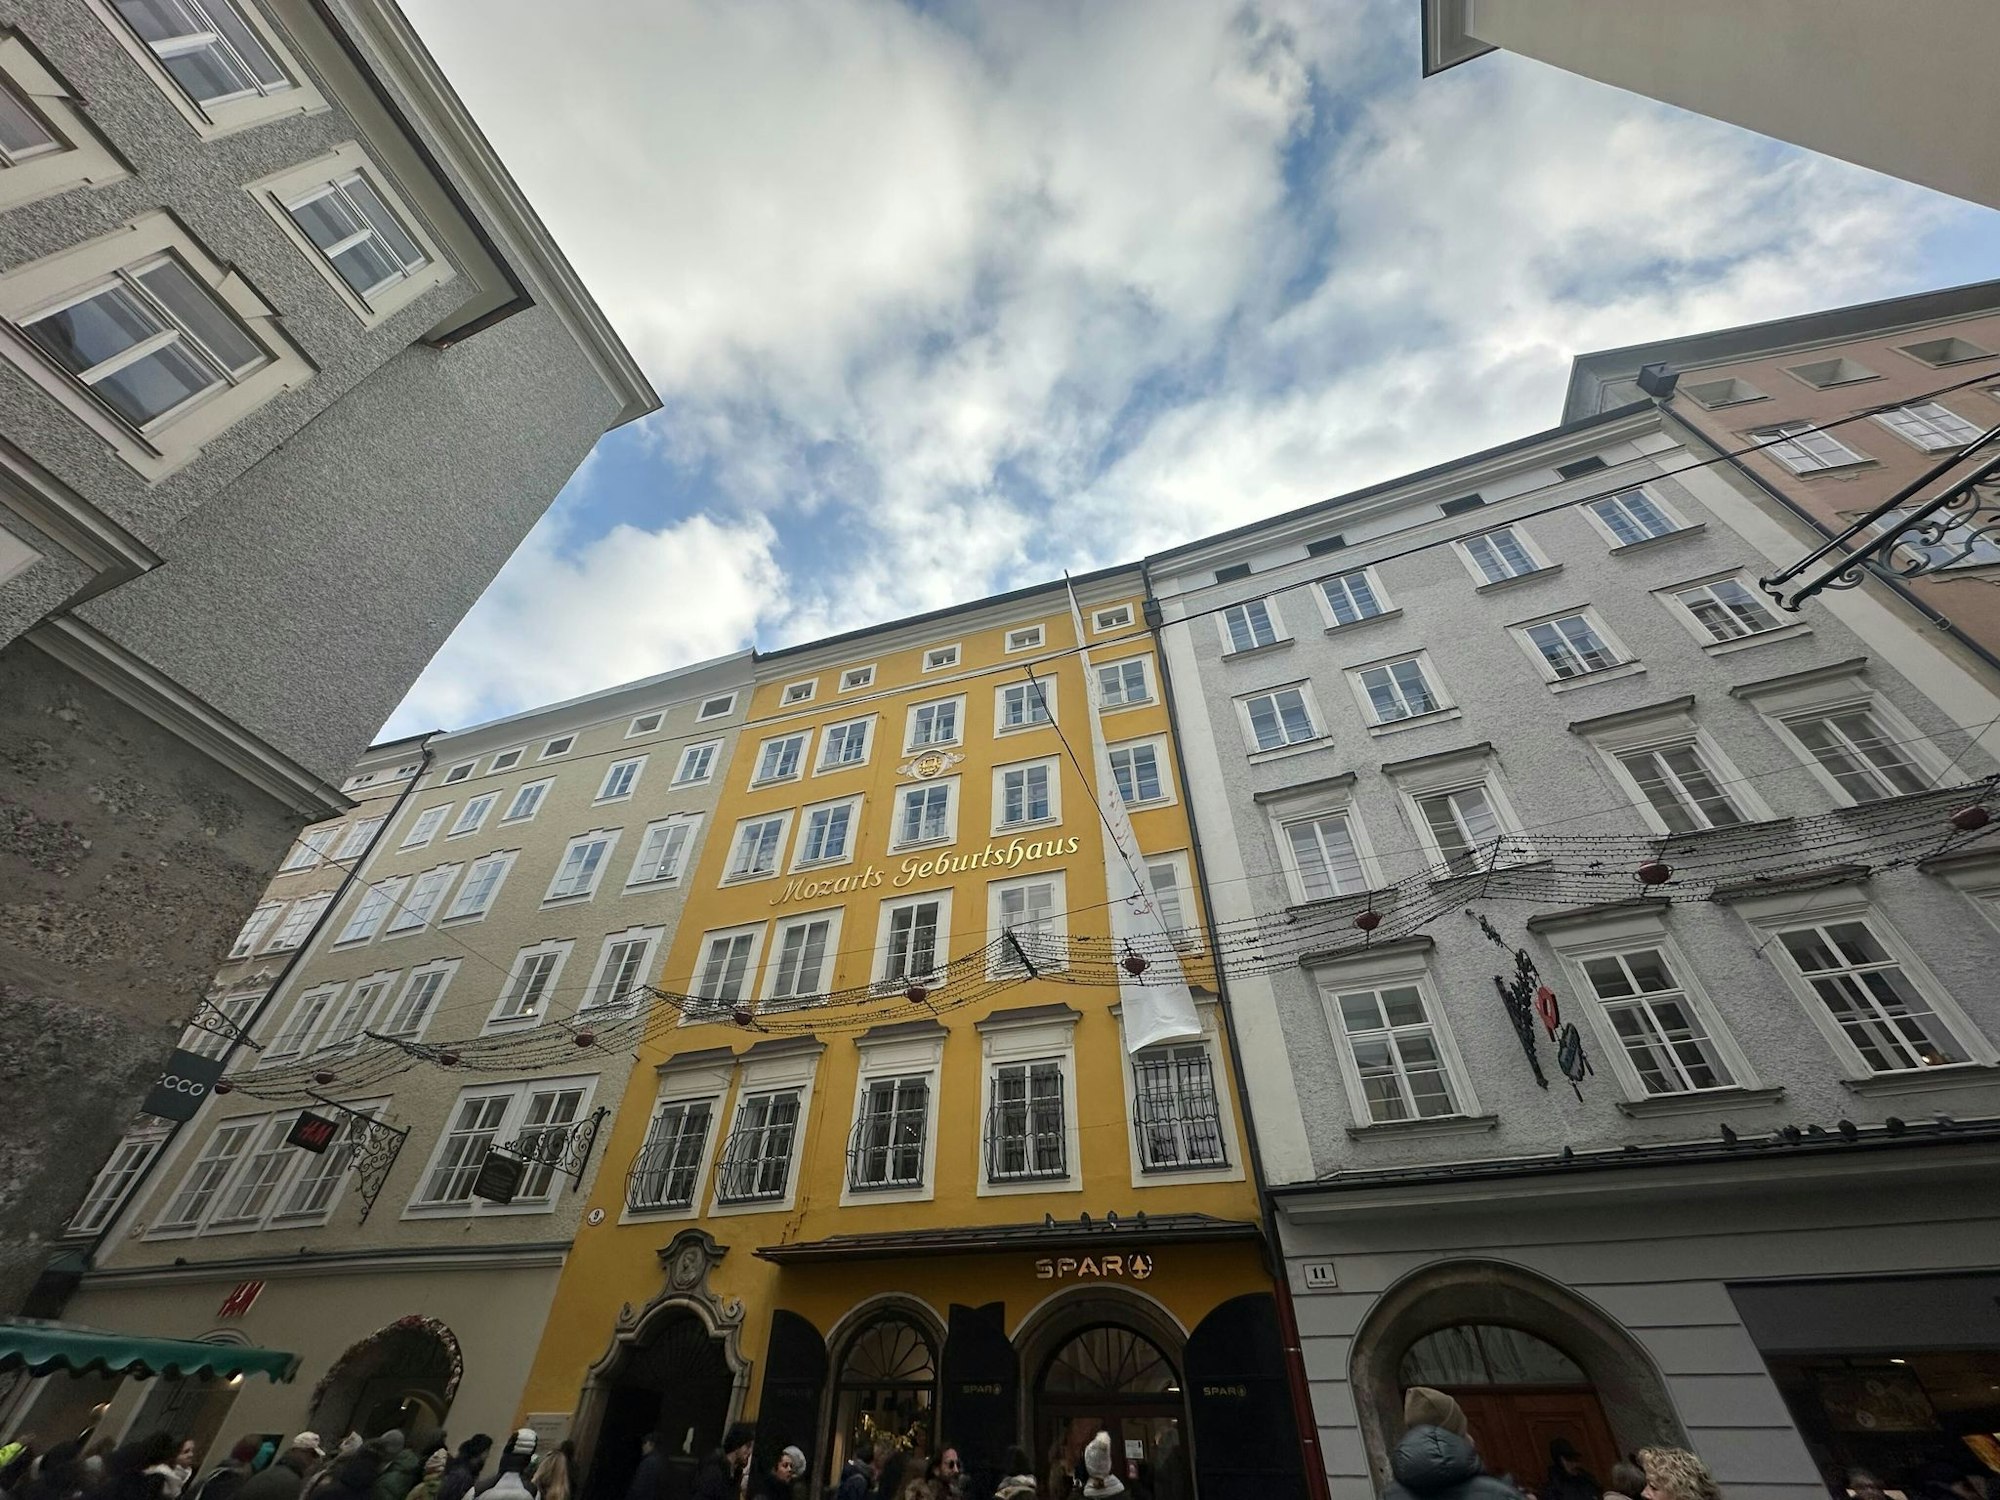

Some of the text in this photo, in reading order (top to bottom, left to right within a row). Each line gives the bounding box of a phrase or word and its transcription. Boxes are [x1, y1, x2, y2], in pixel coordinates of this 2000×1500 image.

[769, 836, 1080, 907] Mozarts Geburtshaus
[1035, 1255, 1123, 1279] SPAR
[1312, 1266, 1326, 1279] 11
[962, 1385, 992, 1394] SPAR
[1203, 1386, 1236, 1396] SPAR
